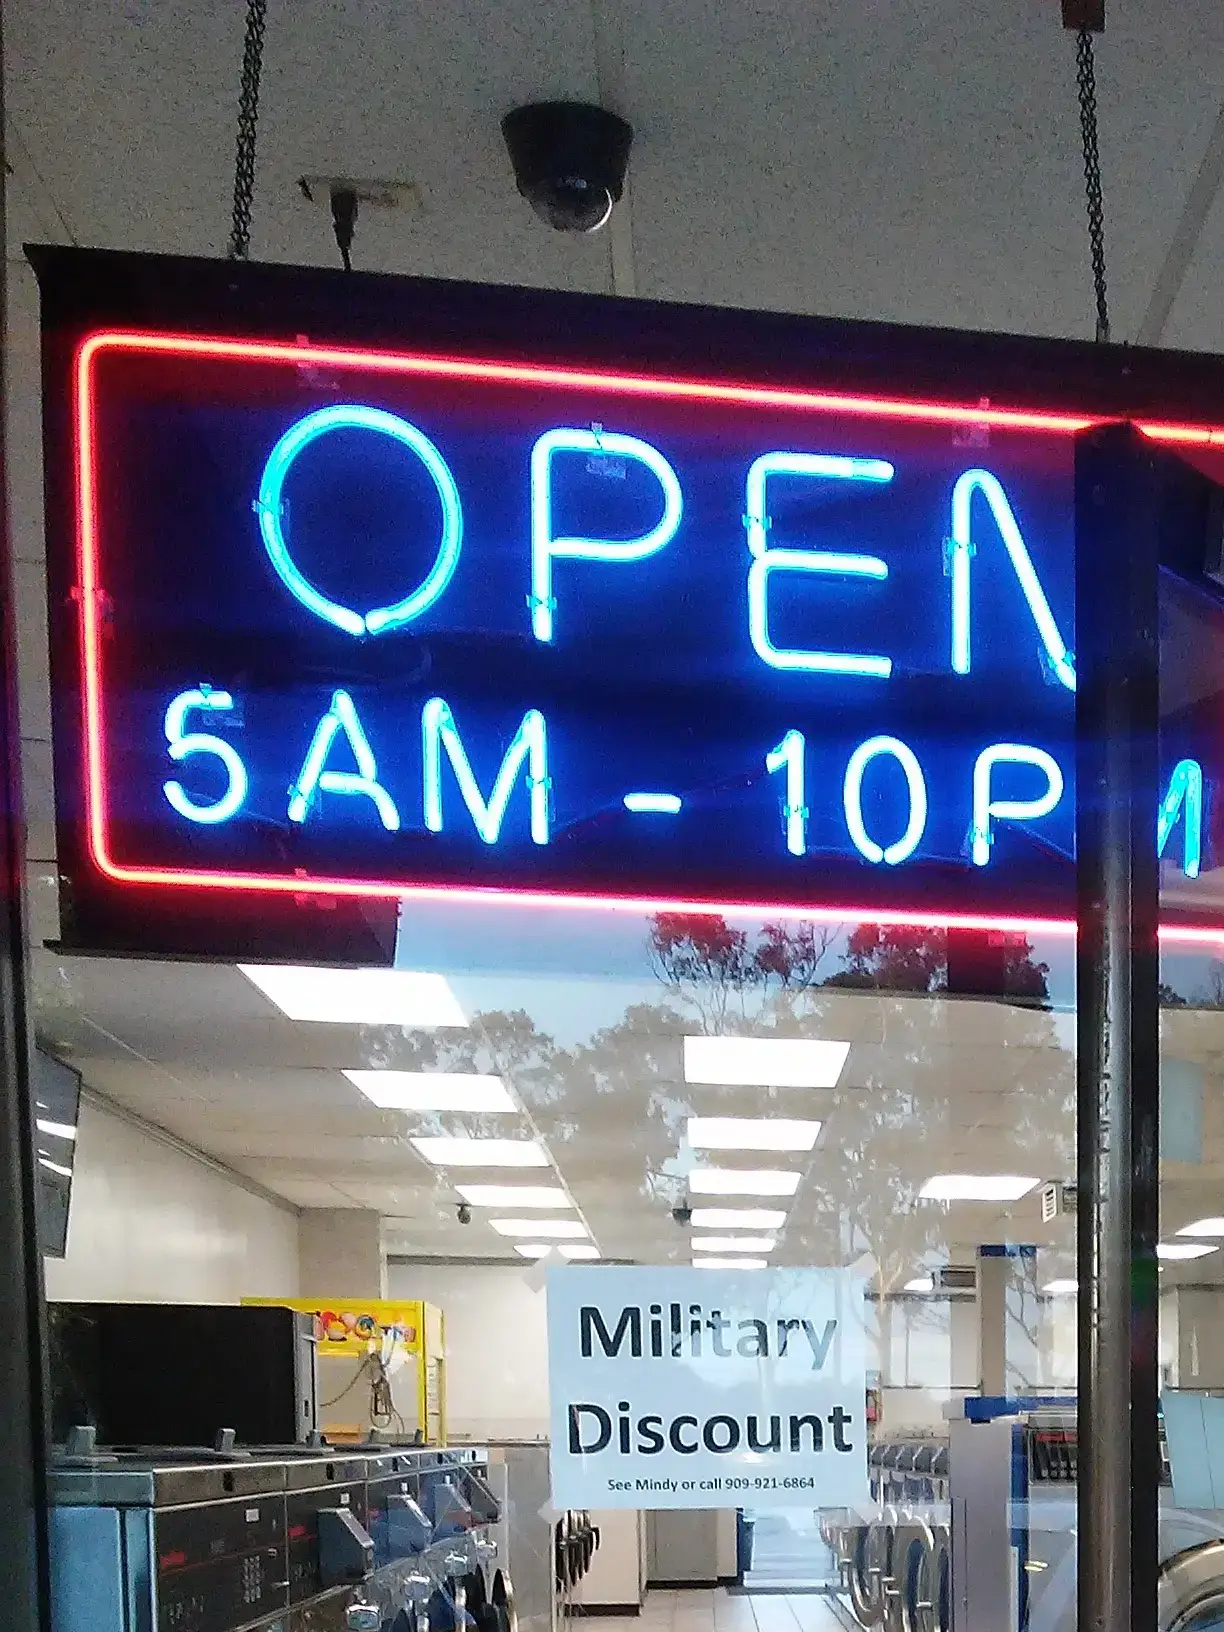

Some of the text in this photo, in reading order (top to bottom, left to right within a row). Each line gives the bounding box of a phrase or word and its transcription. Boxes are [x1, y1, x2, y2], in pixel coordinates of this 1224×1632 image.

[258, 403, 1077, 693] OPEN
[580, 1302, 838, 1371] Military
[568, 1401, 853, 1455] Discount
[607, 1476, 815, 1492] See Mindy or call 909-921-6864
